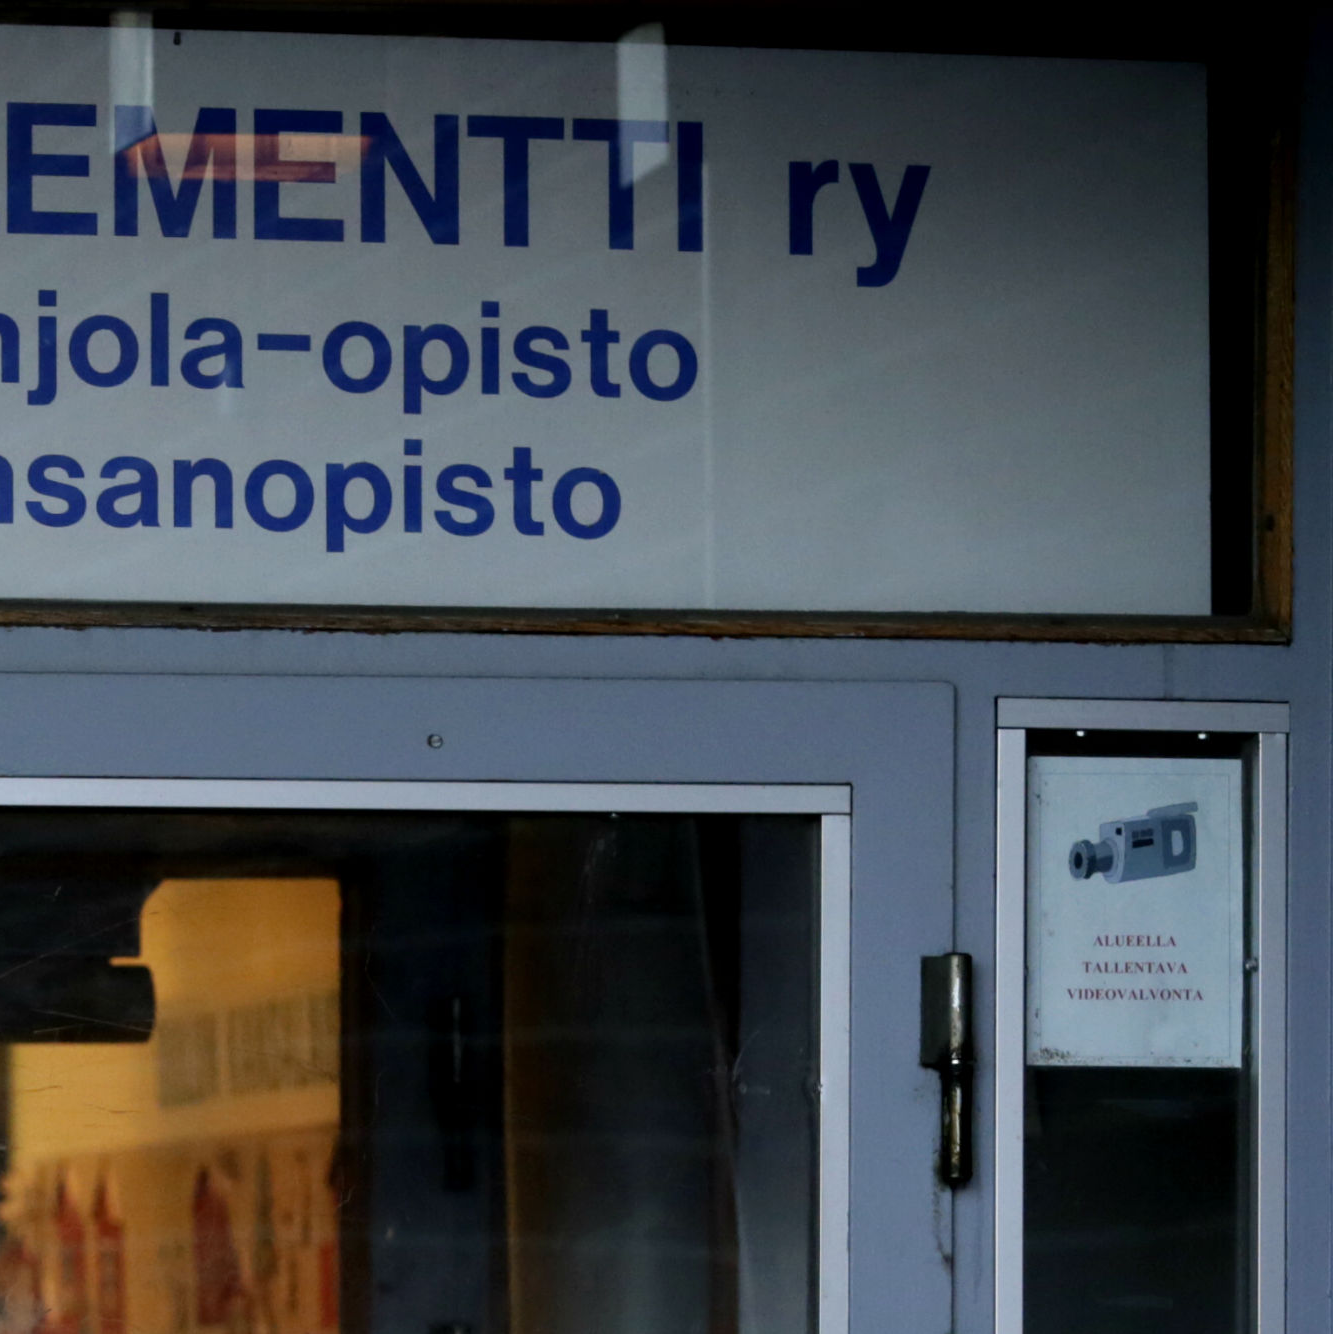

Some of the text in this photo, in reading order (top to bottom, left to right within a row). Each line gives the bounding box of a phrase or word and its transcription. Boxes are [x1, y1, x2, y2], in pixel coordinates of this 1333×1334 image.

[787, 158, 932, 288] ry
[1093, 935, 1177, 948] ALUEELLA
[1082, 960, 1189, 975] TALLENTAVA
[1066, 987, 1204, 1002] VIDEOVALVONTA
